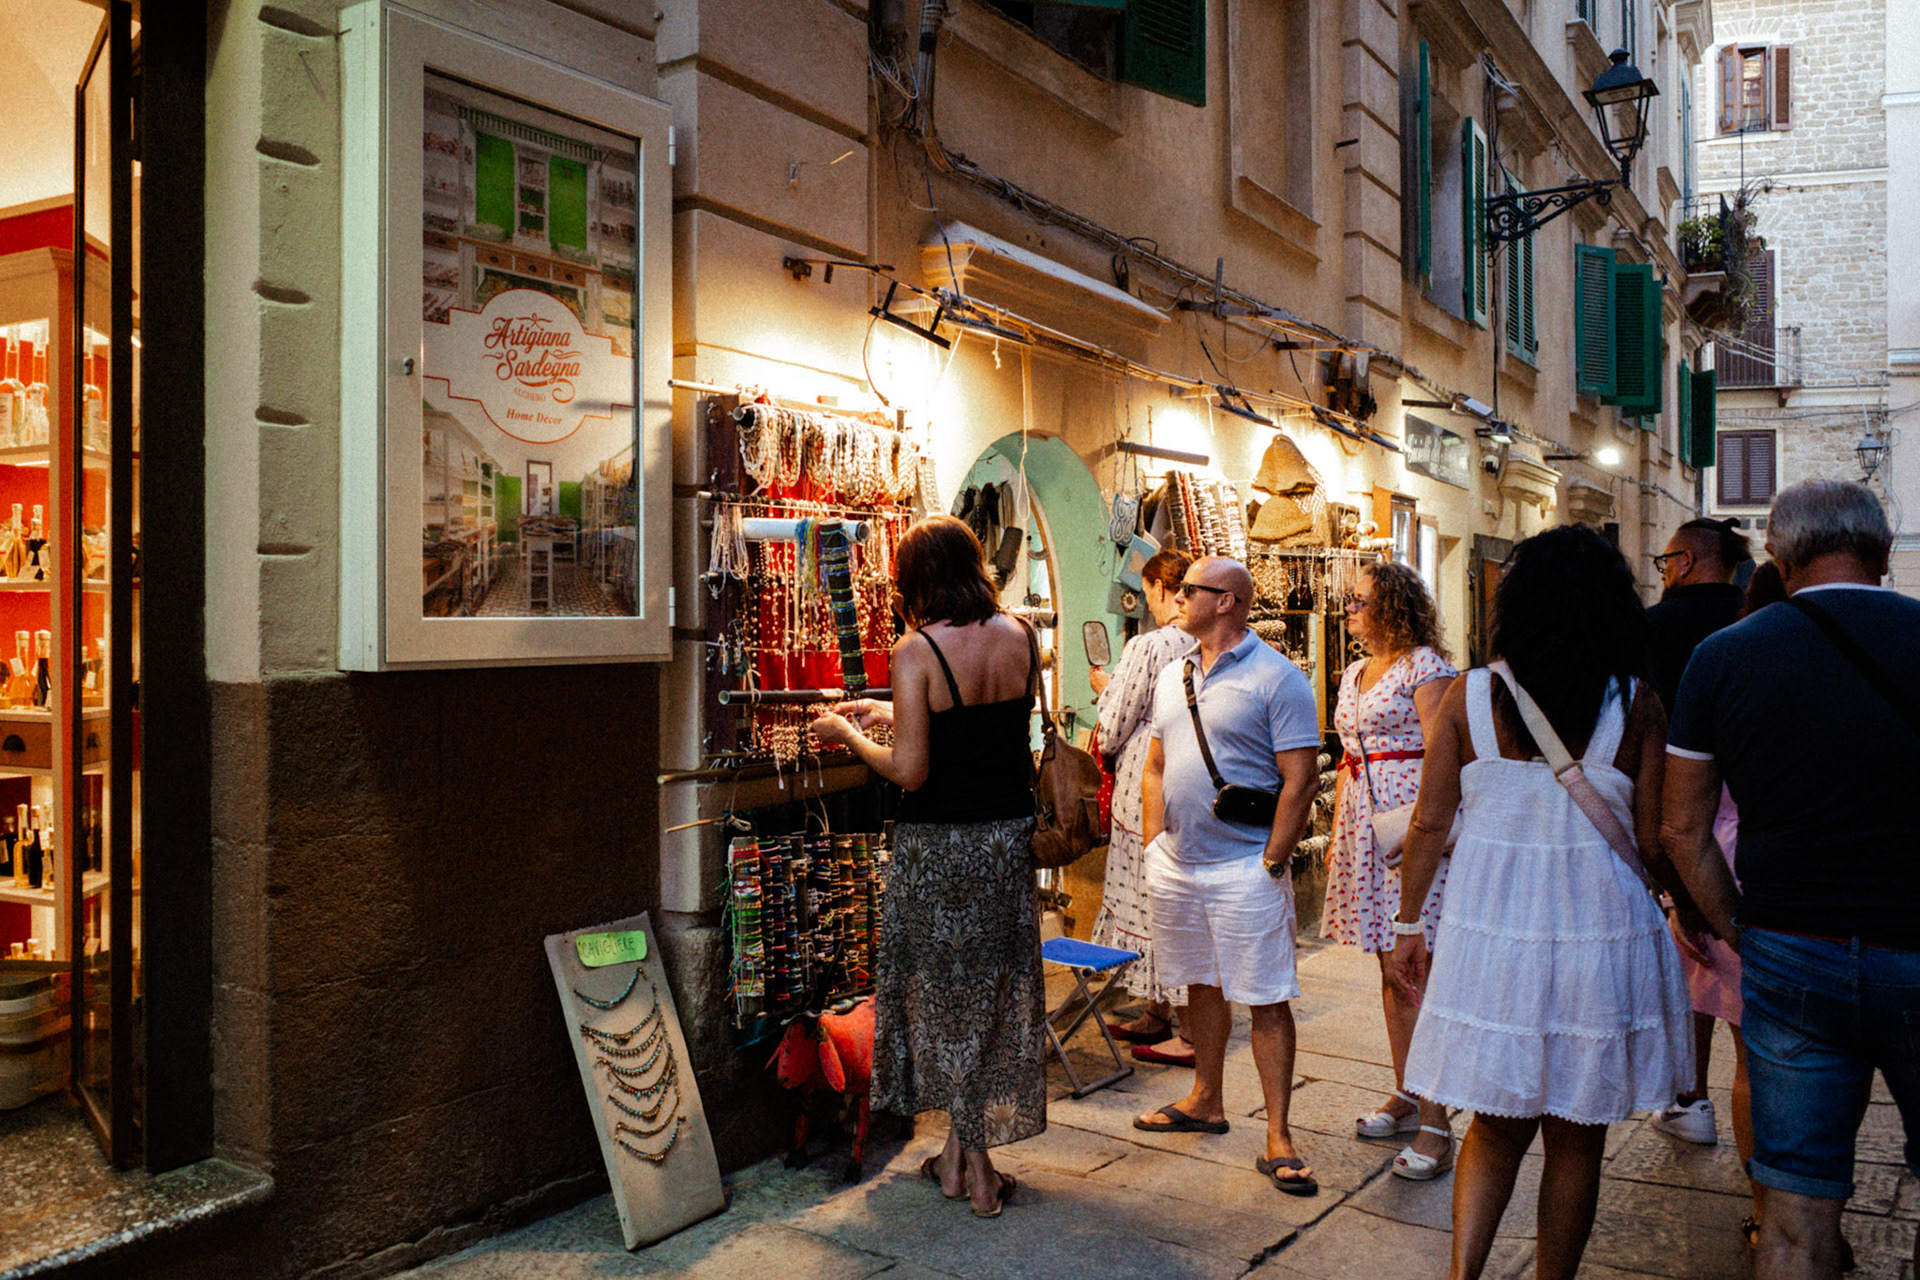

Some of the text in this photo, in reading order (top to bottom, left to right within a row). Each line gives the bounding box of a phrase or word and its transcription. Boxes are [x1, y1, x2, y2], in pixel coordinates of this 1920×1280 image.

[484, 317, 571, 354] Artigiana
[496, 348, 582, 385] Sardegna
[506, 407, 563, 425] Home Decor
